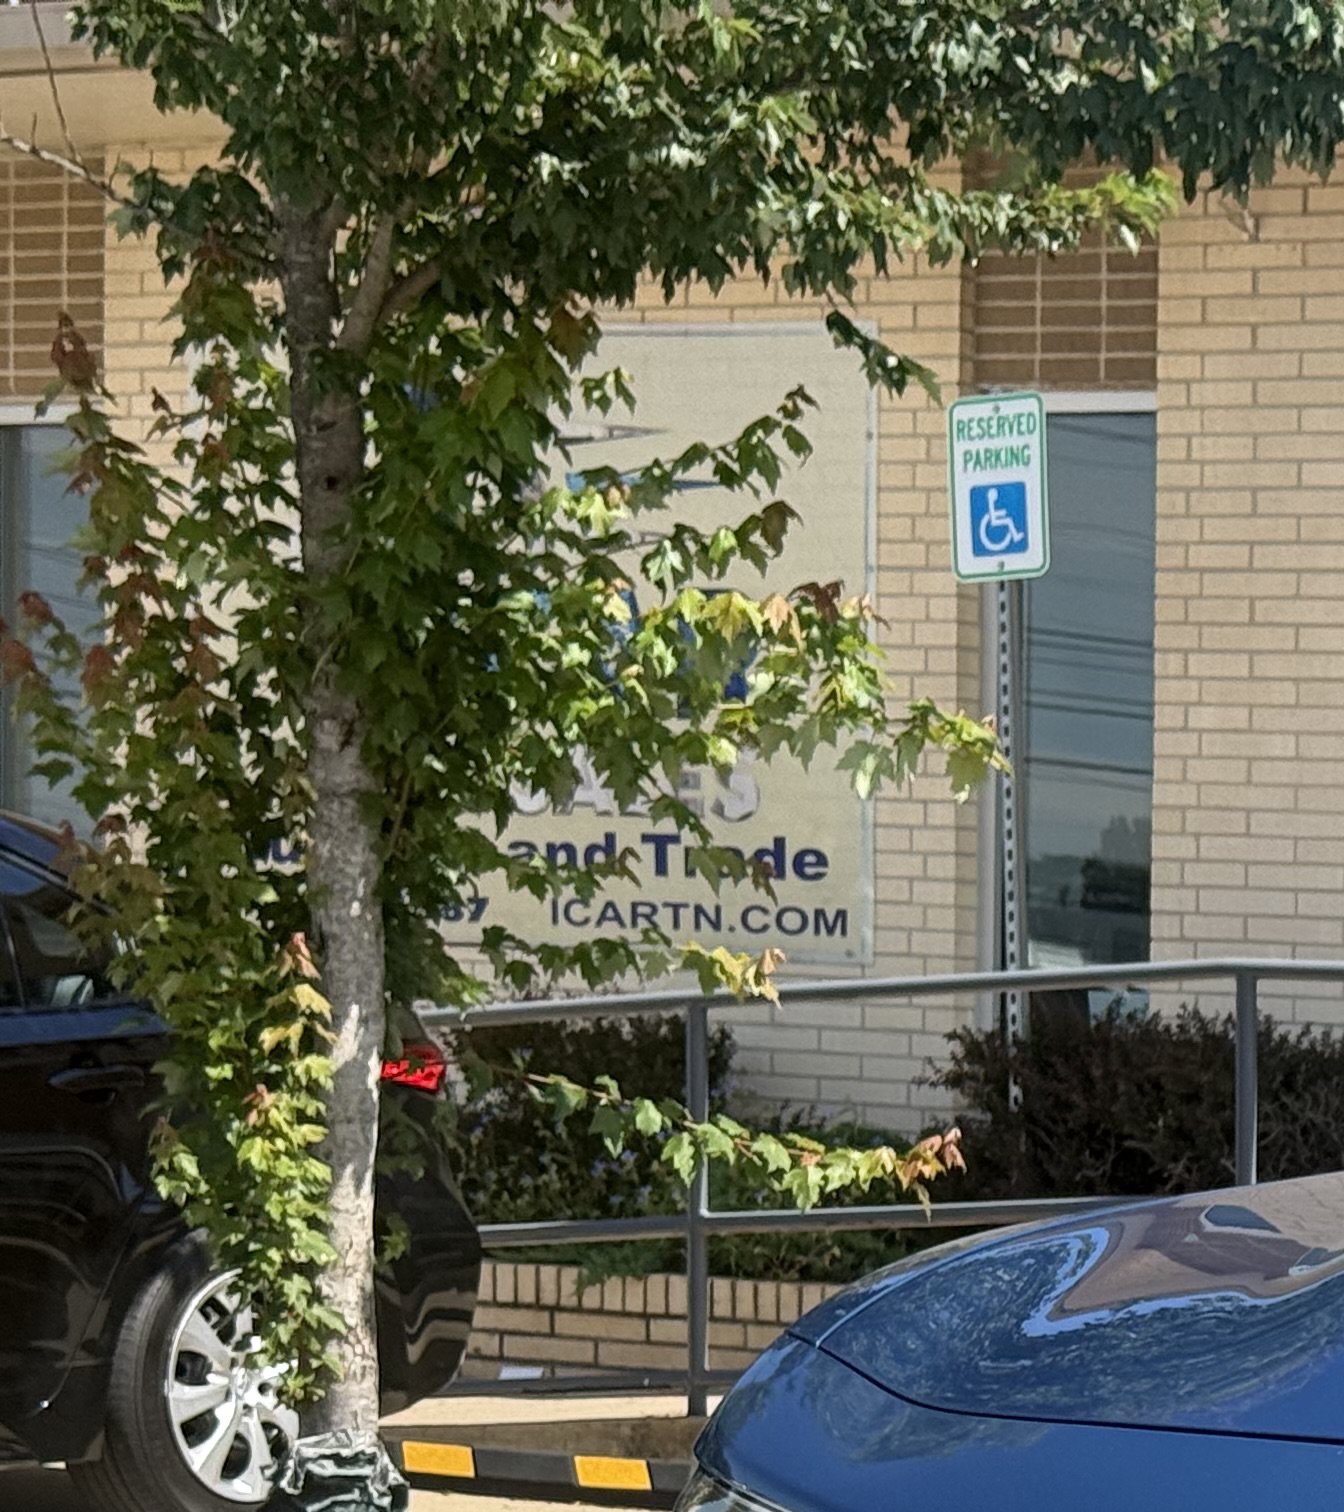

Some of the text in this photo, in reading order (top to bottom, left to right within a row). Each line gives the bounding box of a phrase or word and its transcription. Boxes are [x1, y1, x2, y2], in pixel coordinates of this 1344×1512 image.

[956, 412, 1037, 442] RESERVED
[963, 444, 1031, 473] PARKING
[551, 898, 849, 938] ICARTN.COM
